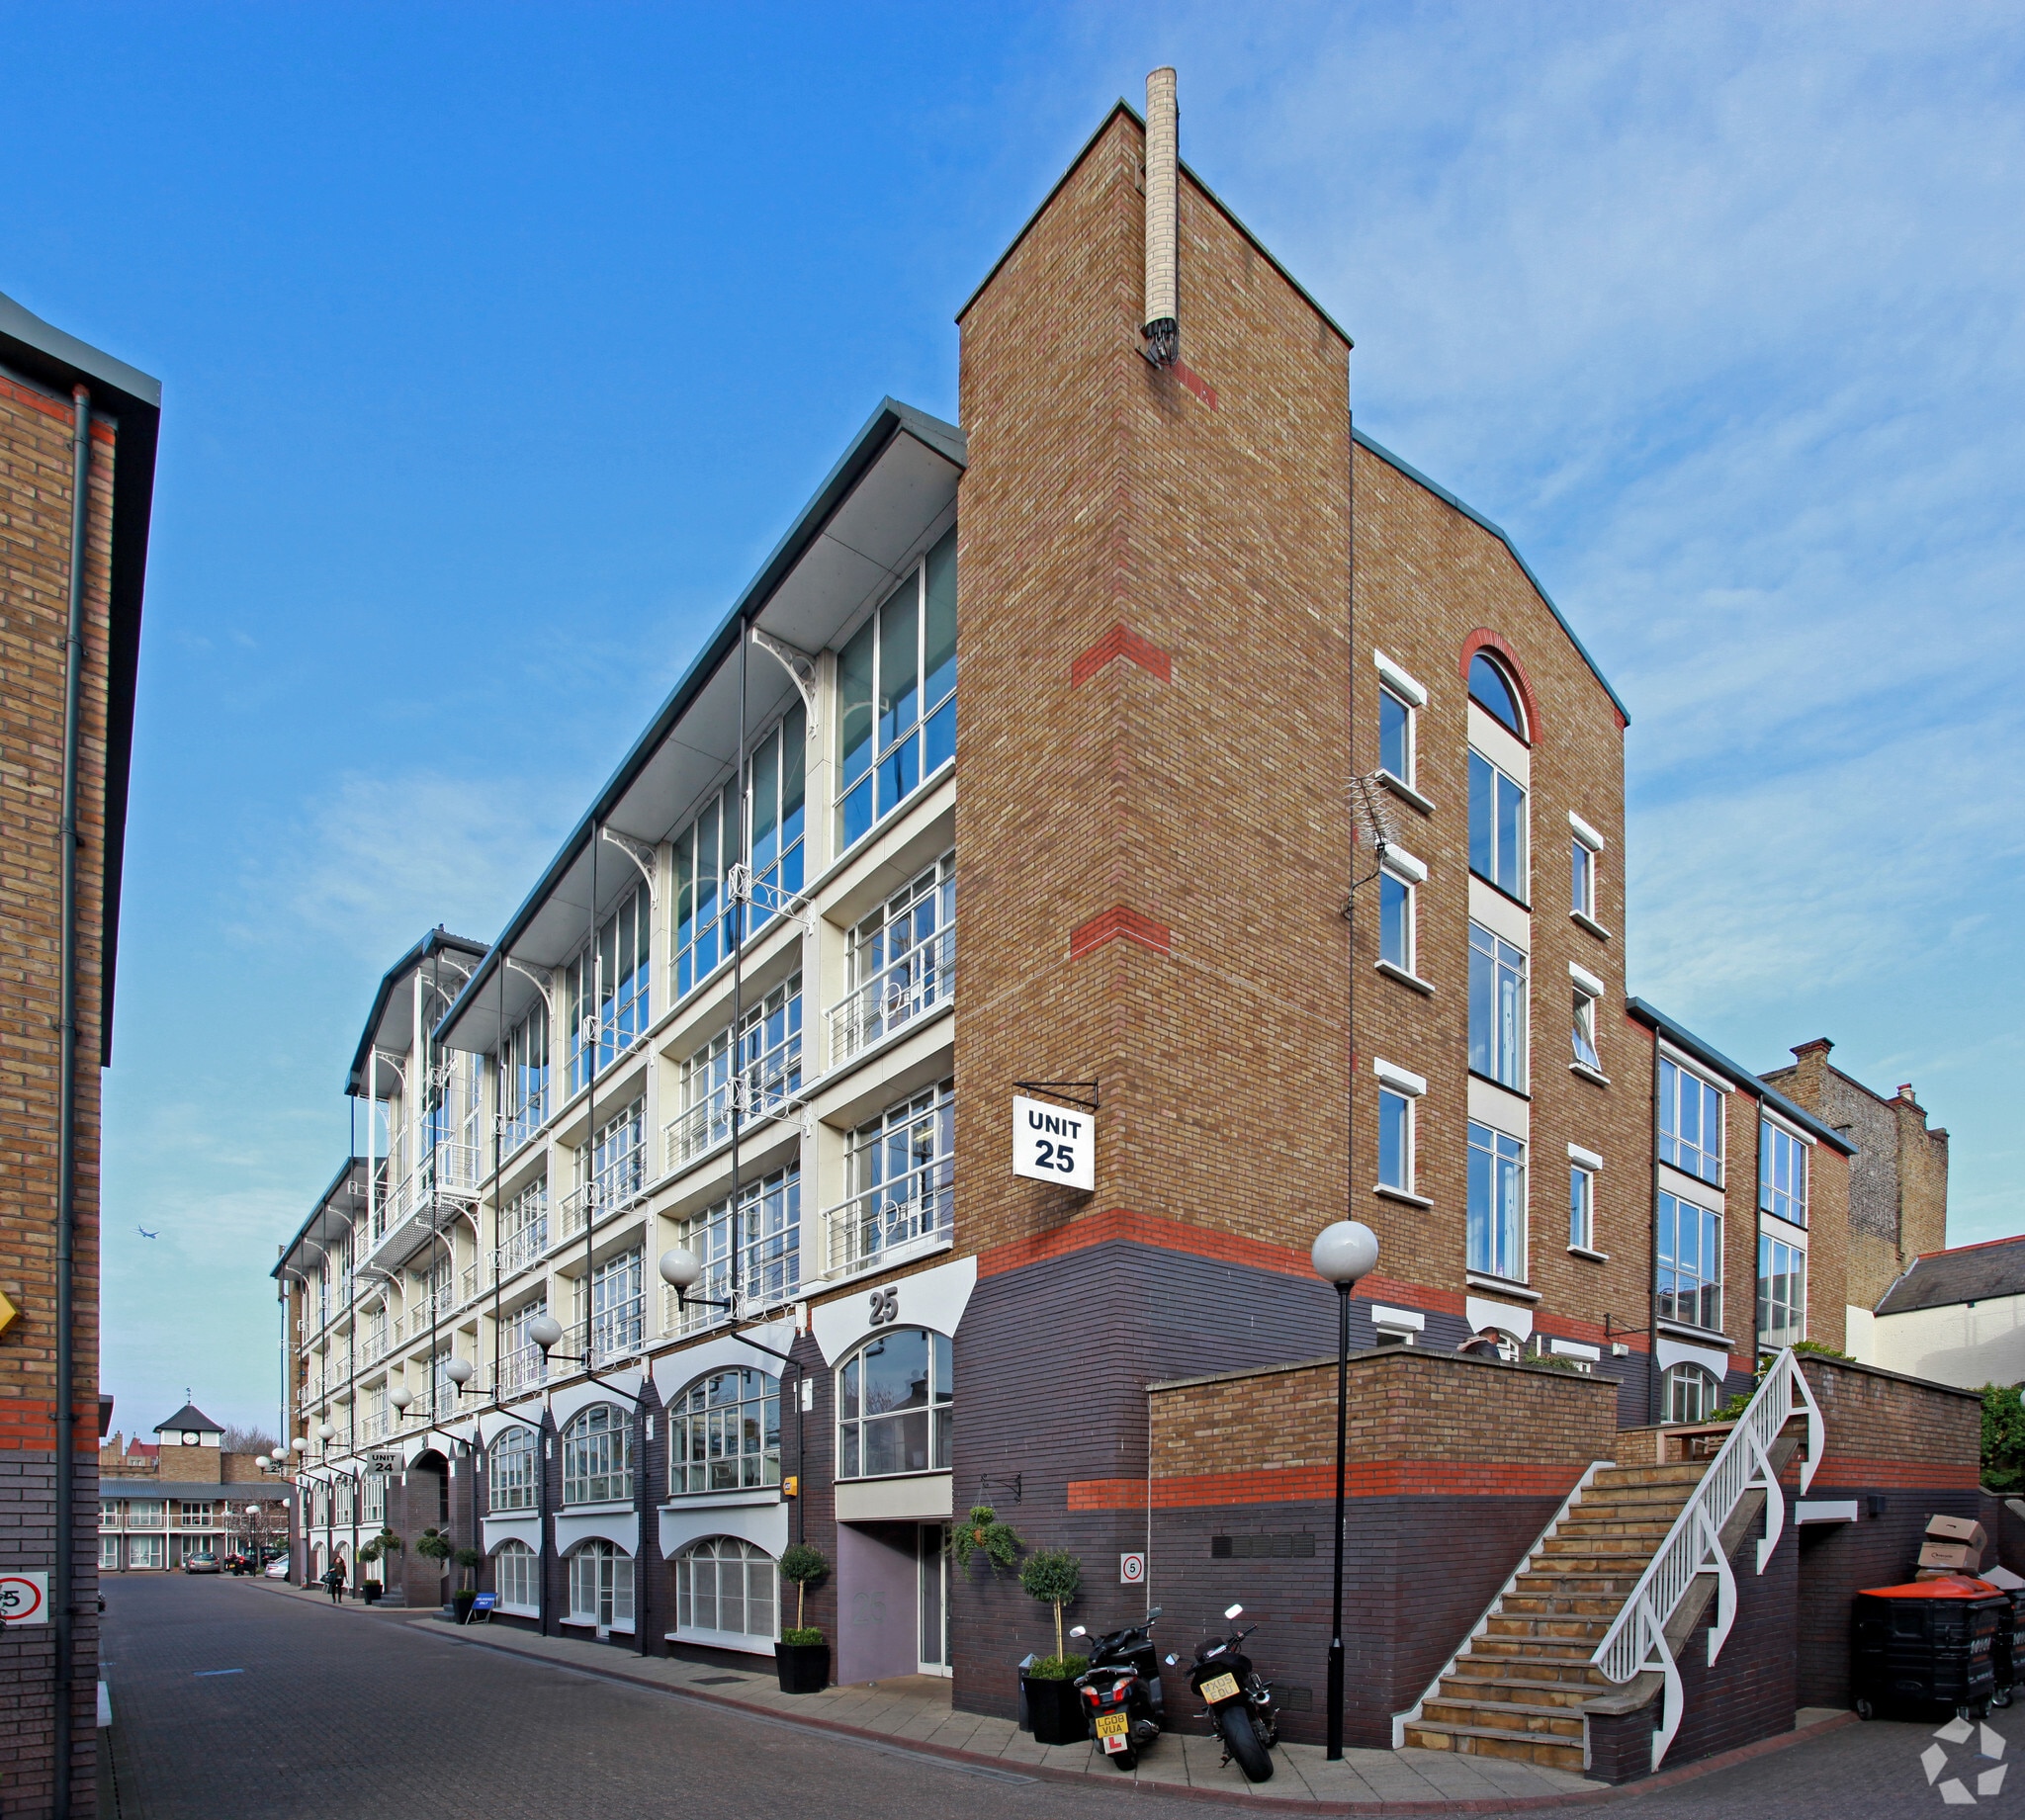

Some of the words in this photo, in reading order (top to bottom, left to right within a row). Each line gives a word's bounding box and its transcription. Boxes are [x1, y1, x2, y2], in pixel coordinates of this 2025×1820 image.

[1028, 1109, 1082, 1139] UNIT
[1034, 1139, 1075, 1173] 25
[869, 1286, 899, 1326] 25
[375, 1463, 394, 1472] 24
[1129, 1563, 1136, 1573] 5
[3, 1590, 21, 1607] 5
[1098, 1714, 1125, 1728] LG08
[1101, 1723, 1123, 1735] VUA
[1107, 1736, 1122, 1750] L
